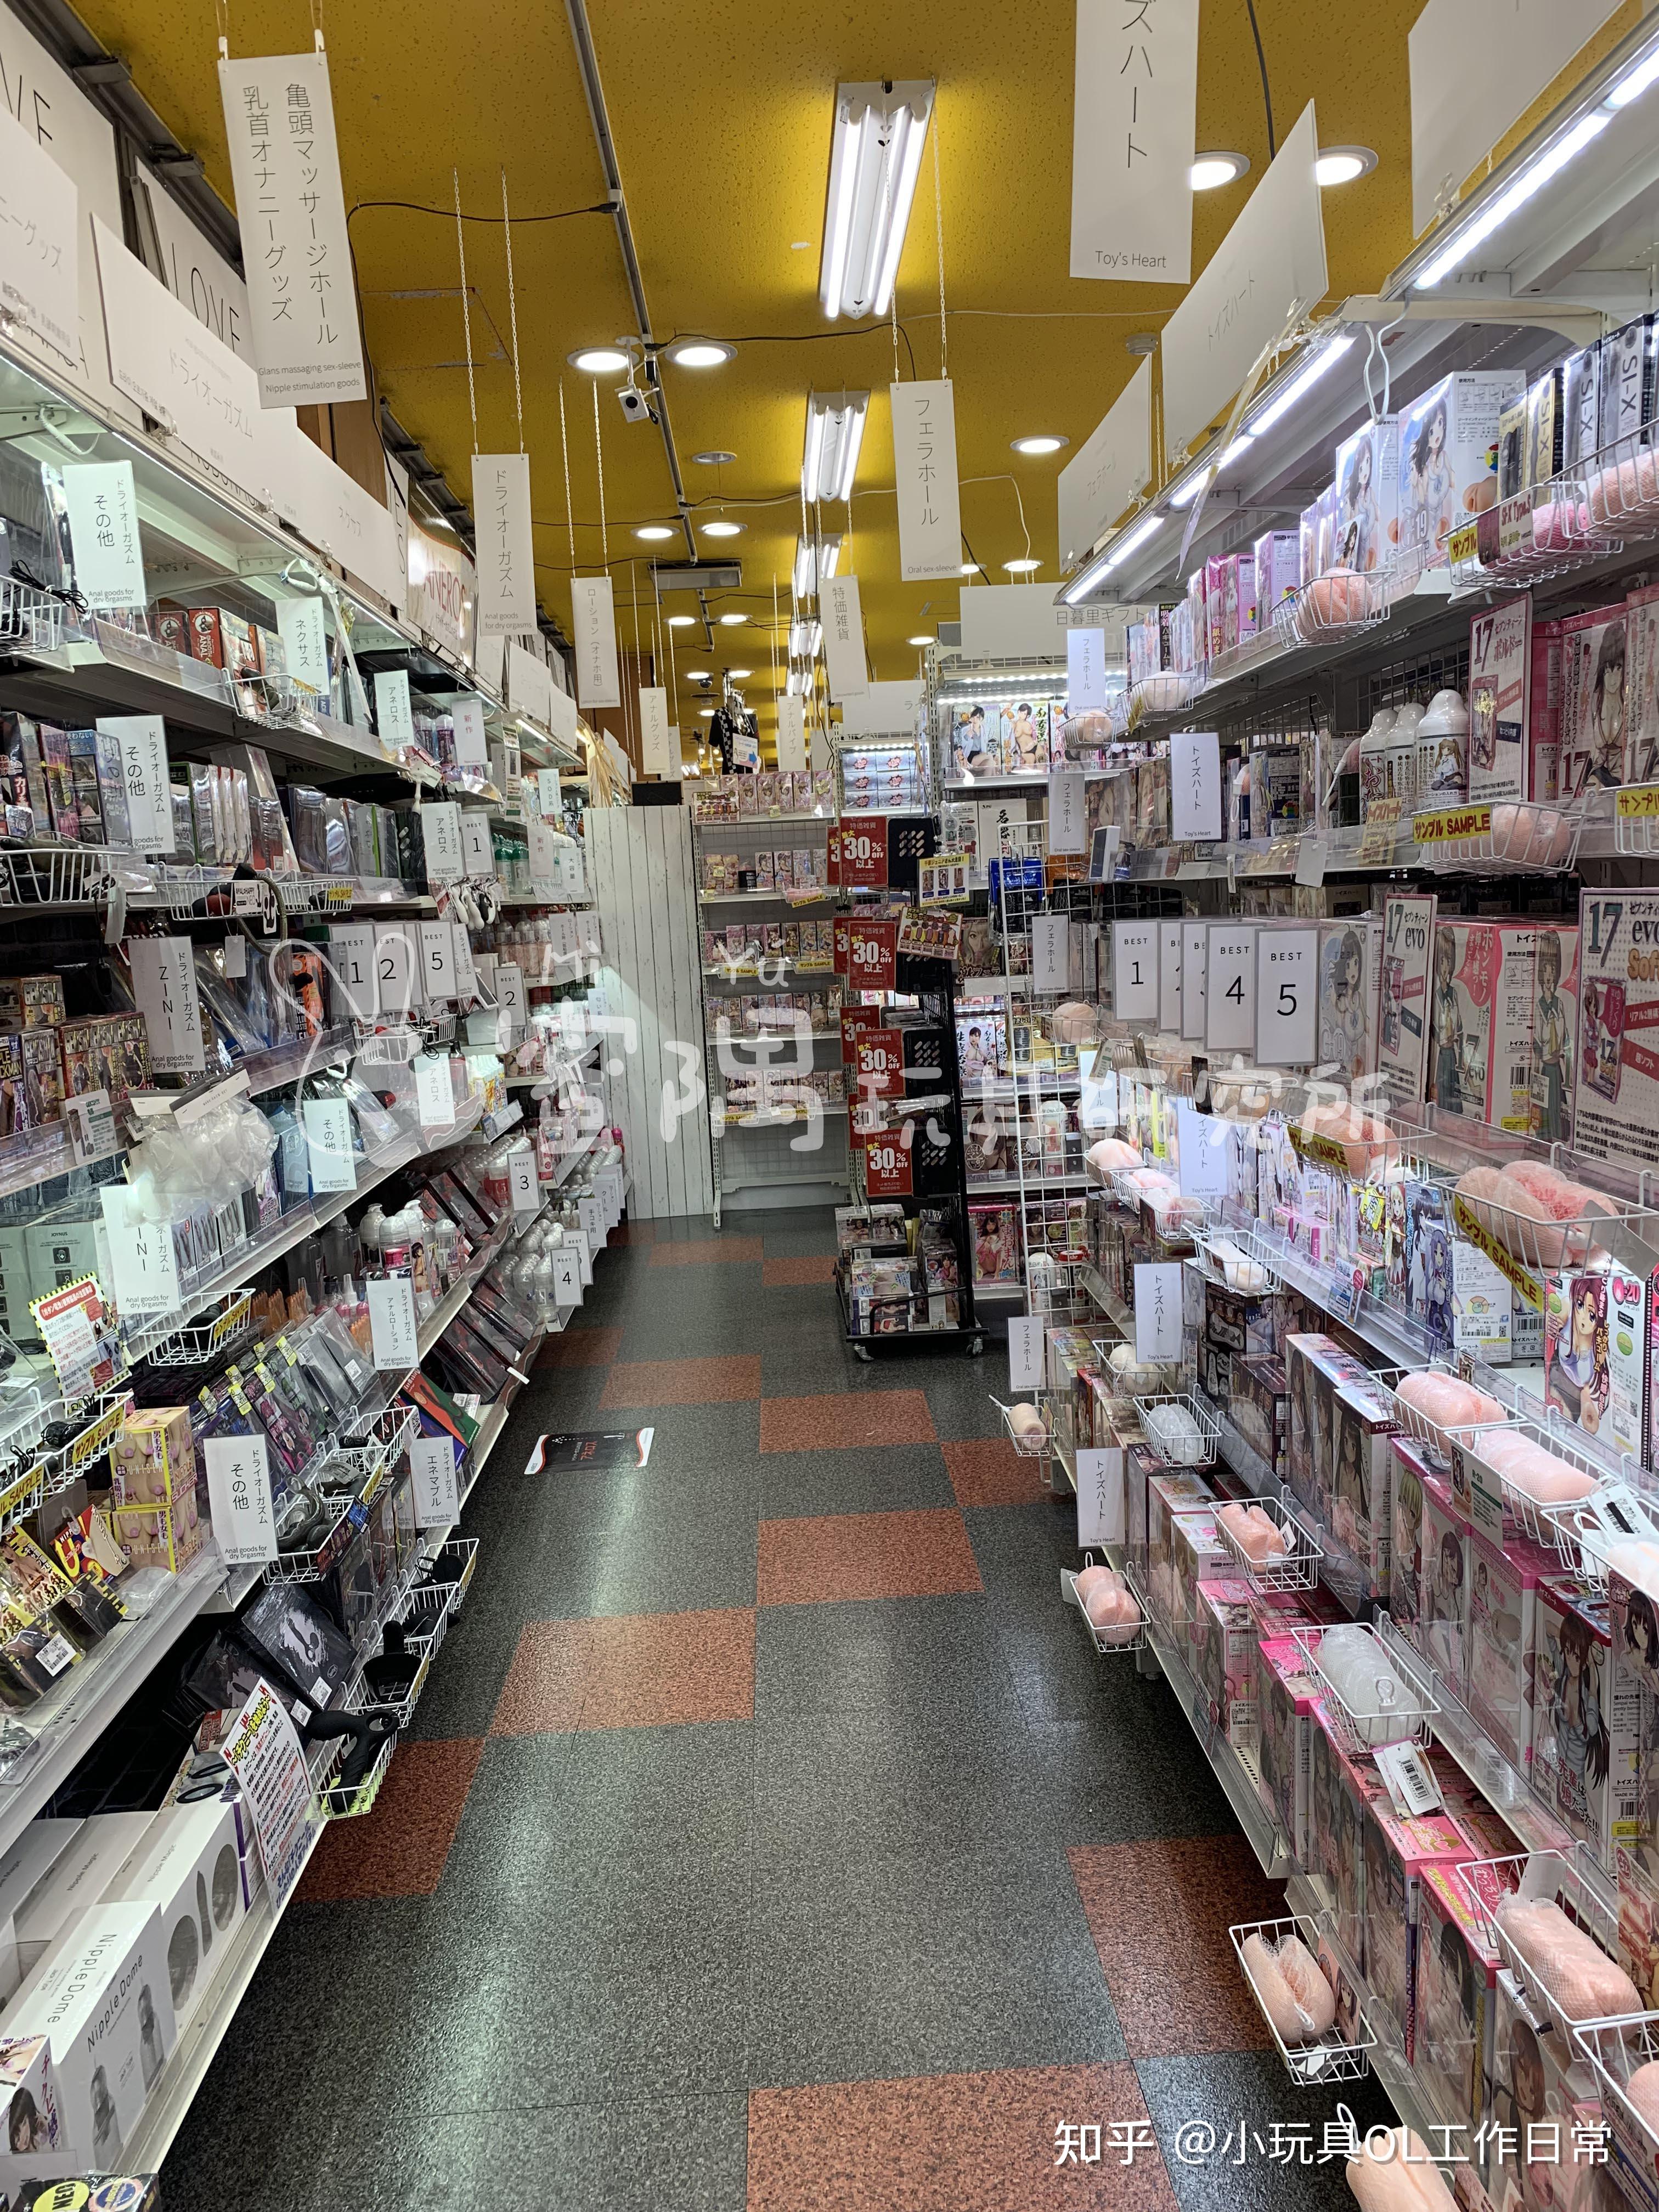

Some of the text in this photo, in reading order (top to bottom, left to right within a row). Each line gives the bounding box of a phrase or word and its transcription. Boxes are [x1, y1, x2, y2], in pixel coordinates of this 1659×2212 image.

[243, 86, 292, 322] 乳首オナニーグッズ
[285, 83, 338, 345] 亀頭マッサージホール
[1096, 251, 1166, 268] Toy's Heart
[258, 360, 361, 376] Glans massaging sex-sleeve
[266, 378, 360, 394] Nipple stimulation goods
[1621, 354, 1638, 416] SI-X
[1581, 379, 1593, 437] SI-X
[915, 400, 939, 526] フェラホール
[94, 495, 114, 548] その他
[117, 479, 135, 564] ドライオーガズム
[495, 470, 514, 598] ドライオーガズム
[1453, 535, 1477, 557] サンプル
[920, 565, 956, 573] sex-sleeve
[104, 590, 123, 598] goods
[105, 595, 132, 603] orgasms
[495, 622, 505, 630] dry
[499, 612, 518, 620] goods
[832, 586, 850, 641] 特価雑貨
[295, 619, 310, 667] ネクサス
[1475, 618, 1494, 672] 17
[1083, 639, 1091, 690] フェラホール
[388, 687, 400, 724] アネロス
[464, 714, 474, 735] 新作
[650, 696, 660, 751] アナルグッズ
[126, 747, 145, 797] その他
[149, 731, 165, 812] ドライオーガズム
[1190, 746, 1201, 811] トイズハート
[1063, 783, 1071, 833] フェラホール
[1414, 814, 1491, 839] サンプル SAMPLE
[436, 817, 447, 854] アネロス
[473, 837, 482, 853] 1
[856, 859, 874, 868] 以上
[1387, 903, 1404, 945] 17
[1405, 927, 1425, 950] evo
[1588, 901, 1624, 967] 17
[431, 952, 443, 970] 5
[1047, 924, 1056, 973] フェラホール
[1220, 946, 1250, 955] BEST
[1271, 952, 1302, 961] BEST
[351, 962, 364, 984] 1
[380, 959, 396, 980] 2
[864, 964, 883, 973] 以上
[1131, 962, 1144, 985] 1
[178, 952, 195, 1031] ドライオーガズム
[505, 991, 516, 1006] 2
[1225, 975, 1245, 1005] 4
[1277, 984, 1297, 1016] 5
[167, 1055, 185, 1064] goods
[430, 1068, 441, 1103] アネロス
[323, 1119, 336, 1153] その他
[338, 1109, 350, 1164] ドライオーガズム
[520, 1175, 529, 1190] 3
[881, 1169, 899, 1178] 以上
[1459, 1206, 1488, 1250] サンプル
[1492, 1246, 1537, 1303] SAMPLE
[562, 1272, 572, 1285] 4
[140, 1296, 159, 1305] goods
[400, 1288, 412, 1342] ドライオーガズム
[1154, 1275, 1164, 1336] トイズハート
[387, 1297, 399, 1351] アナルローション
[1023, 1325, 1032, 1371] フェラホール
[75, 1412, 121, 1458] サンプル SAMPLE
[8, 1467, 42, 1508] SAMPLE
[230, 1464, 249, 1510] その他
[251, 1450, 268, 1524] ドライオーガズム
[427, 1455, 442, 1507] エネマブル
[443, 1446, 453, 1499] ドライオーガズム
[1096, 1460, 1106, 1519] トイズハート
[229, 1553, 239, 1561] dry
[238, 1547, 257, 1556] goods
[67, 1852, 99, 1892] Nipple Magic
